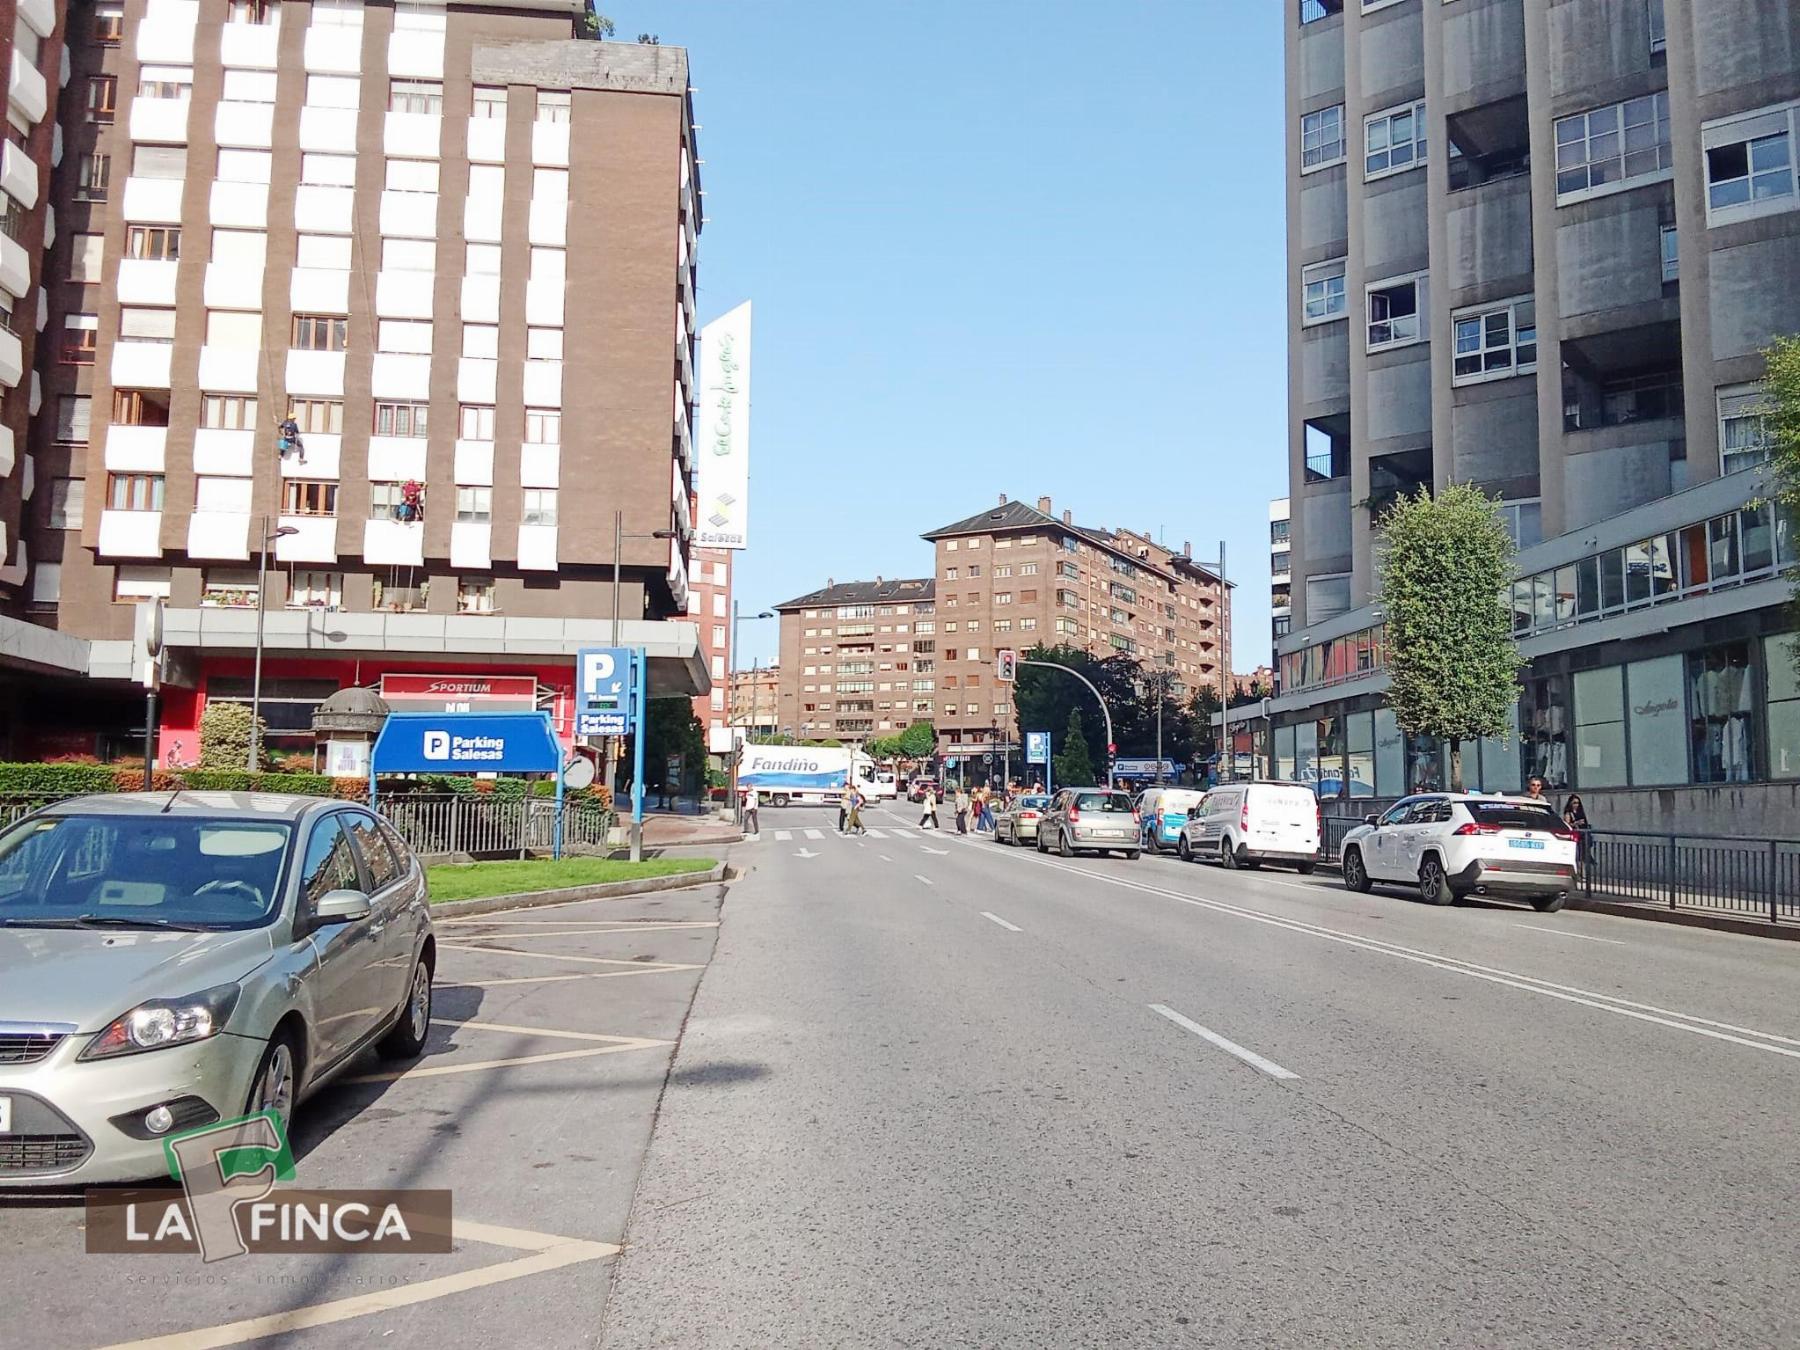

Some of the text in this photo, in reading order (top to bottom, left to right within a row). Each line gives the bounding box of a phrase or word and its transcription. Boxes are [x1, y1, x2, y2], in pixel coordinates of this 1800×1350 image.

[584, 654, 615, 693] P
[424, 680, 491, 693] SPORTIUM
[581, 714, 625, 726] Parking
[580, 723, 625, 734] Salesas
[452, 736, 504, 752] Parking
[452, 749, 504, 760] Salesas
[751, 756, 819, 772] Fandiño
